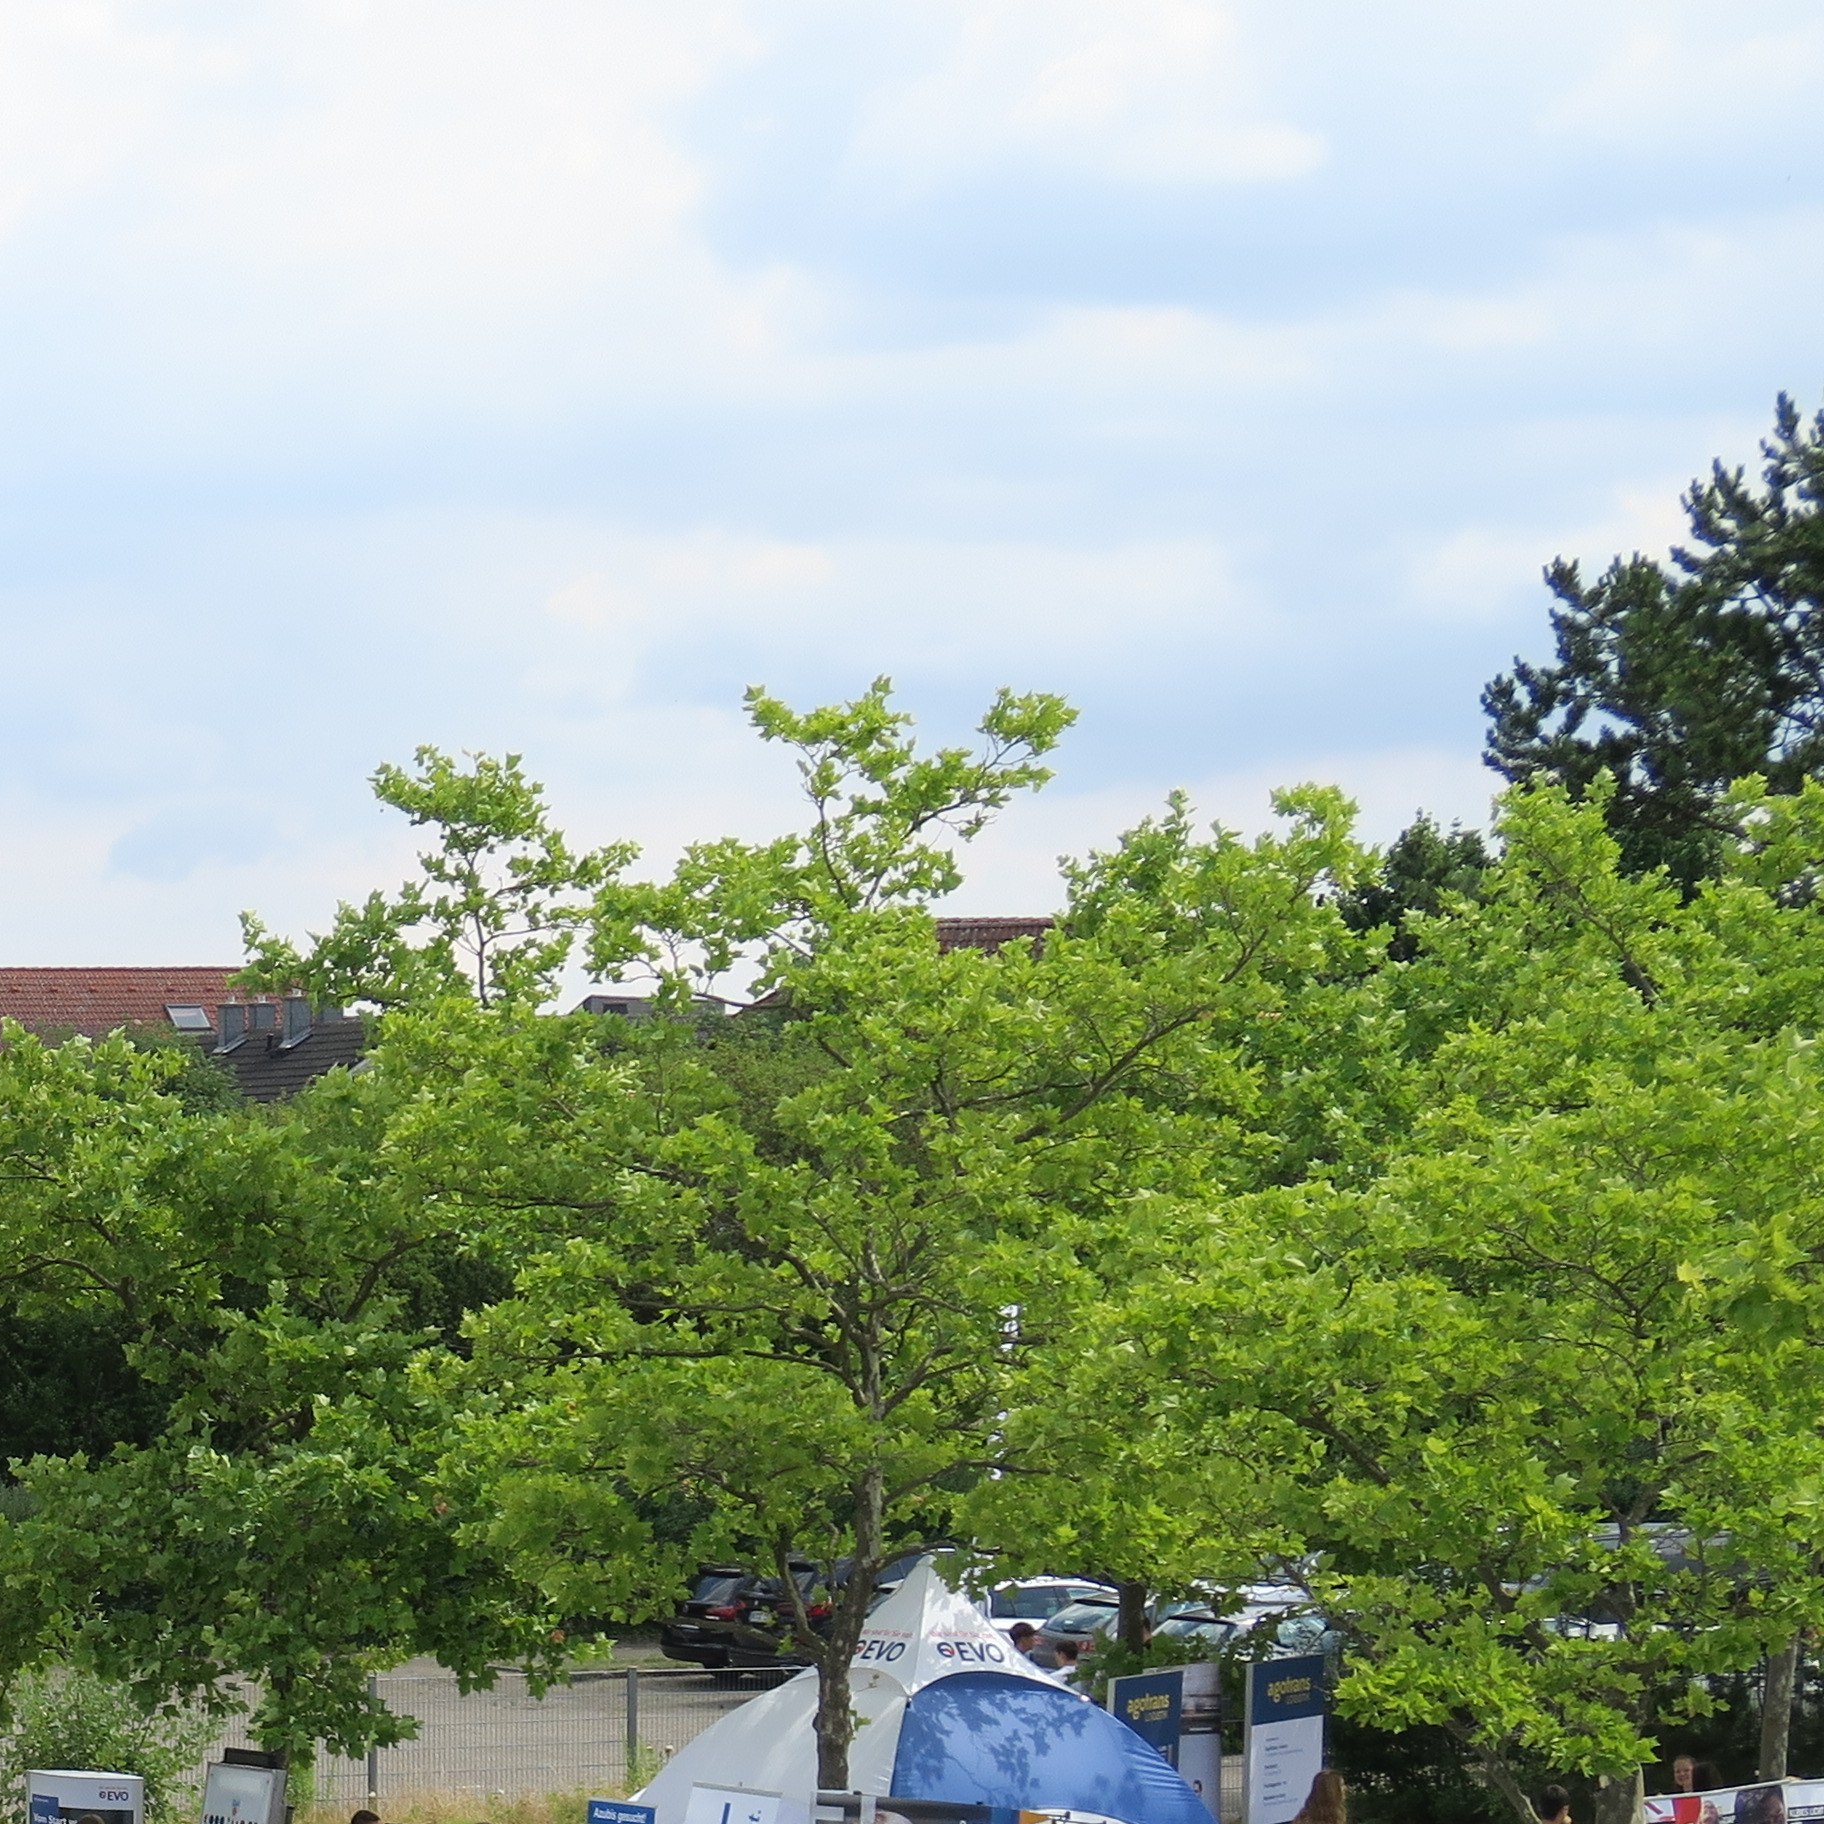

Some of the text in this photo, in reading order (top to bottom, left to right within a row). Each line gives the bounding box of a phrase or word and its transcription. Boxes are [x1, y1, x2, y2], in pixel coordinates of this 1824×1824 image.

[860, 1640, 906, 1662] EVO
[959, 1642, 1005, 1663] EVO
[1268, 1677, 1311, 1703] agotrans
[1127, 1693, 1170, 1720] agotrans
[107, 1791, 129, 1801] EVO
